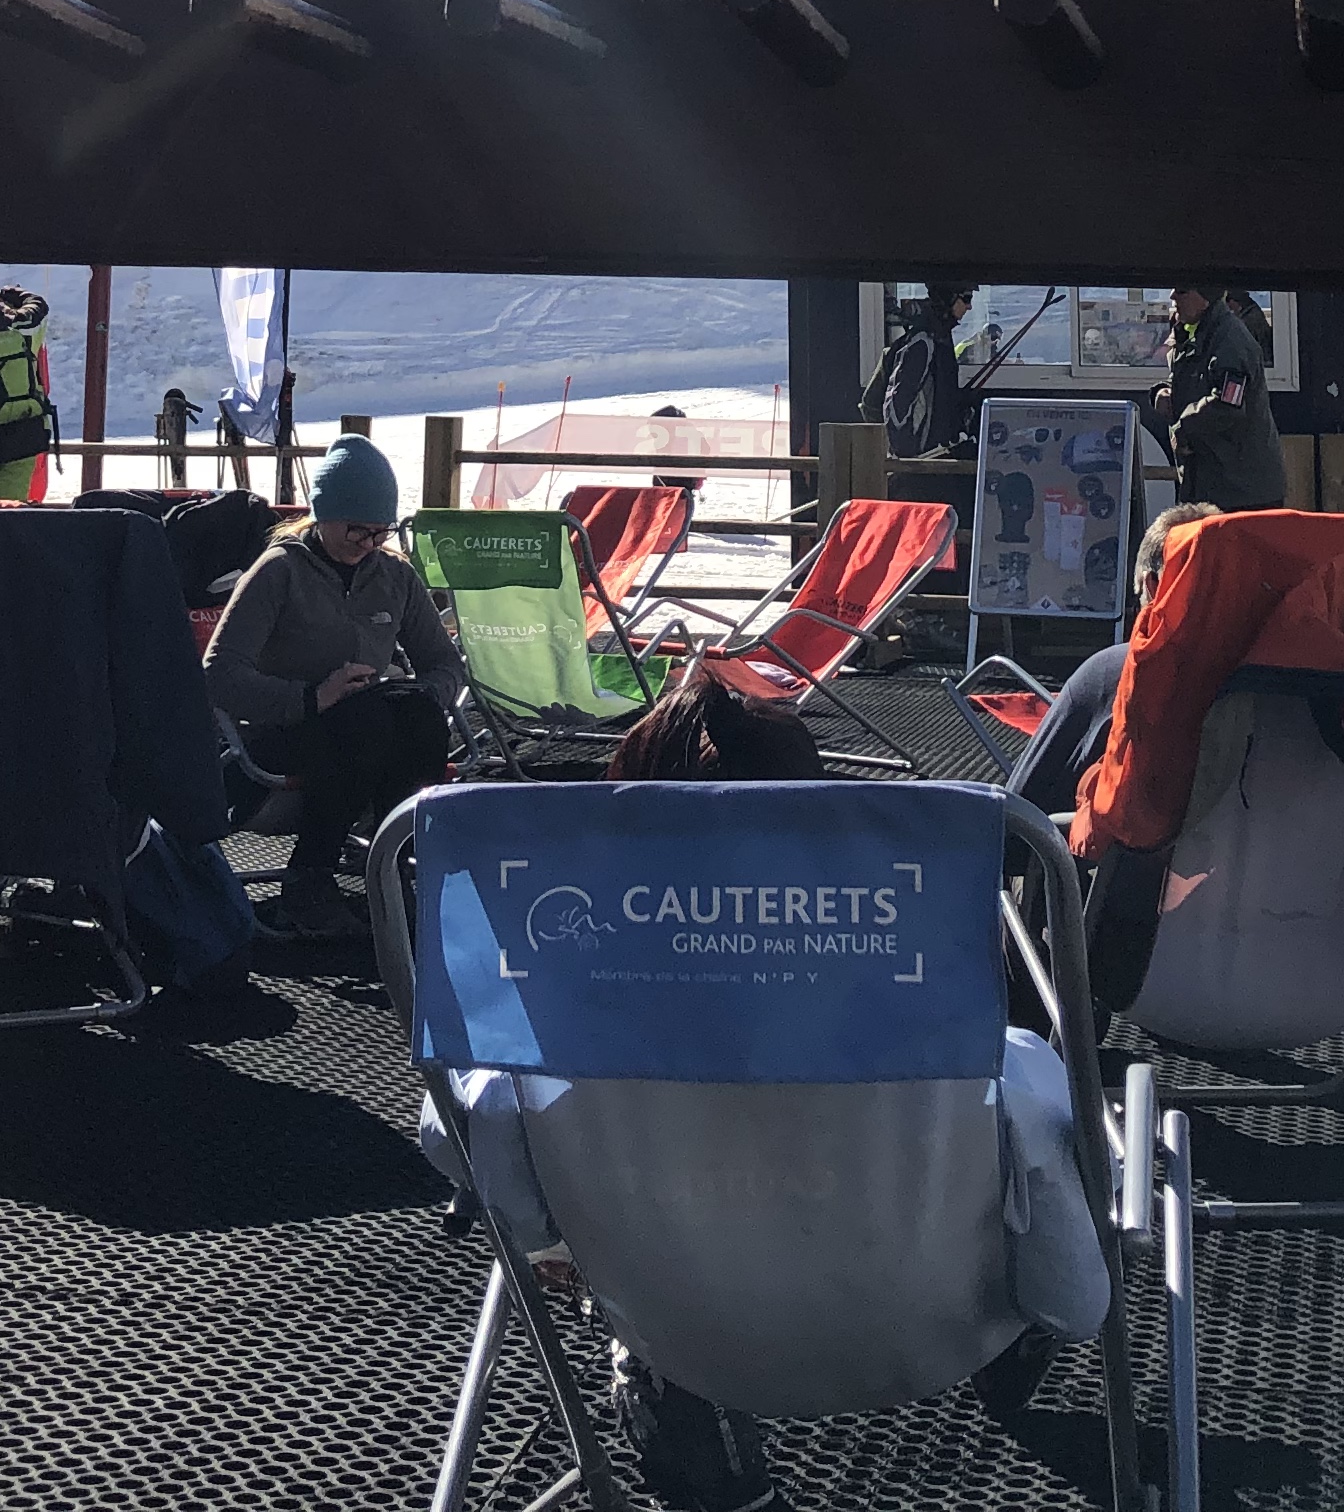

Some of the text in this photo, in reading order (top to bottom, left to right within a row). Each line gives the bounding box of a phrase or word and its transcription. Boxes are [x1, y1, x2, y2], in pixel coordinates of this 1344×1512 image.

[464, 536, 542, 550] CAUTERETS
[622, 885, 898, 925] CAUTERETS
[672, 933, 898, 955] GRAND PAR NATURE
